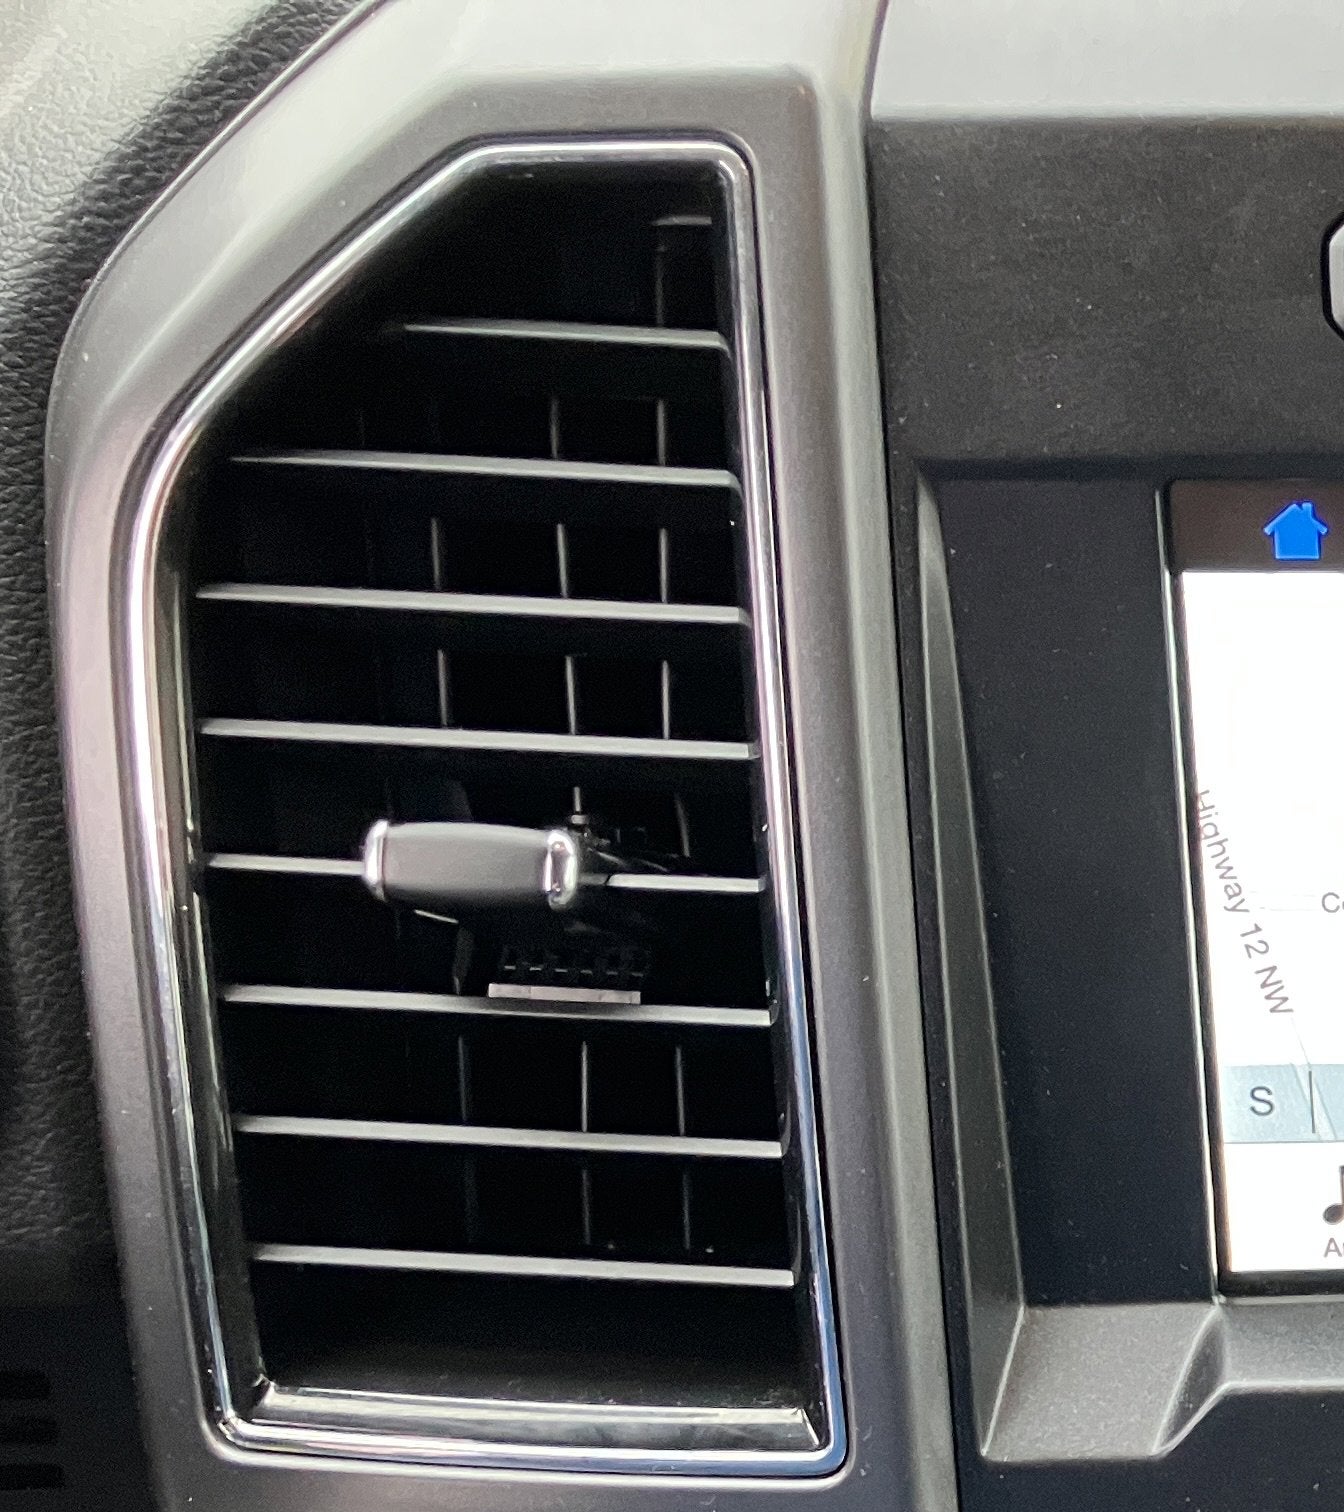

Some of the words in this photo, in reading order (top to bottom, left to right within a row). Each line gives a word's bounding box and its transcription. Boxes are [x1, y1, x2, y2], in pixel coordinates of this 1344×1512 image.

[1239, 922, 1270, 960] 12
[1253, 964, 1295, 1014] NW
[1249, 1086, 1275, 1117] S
